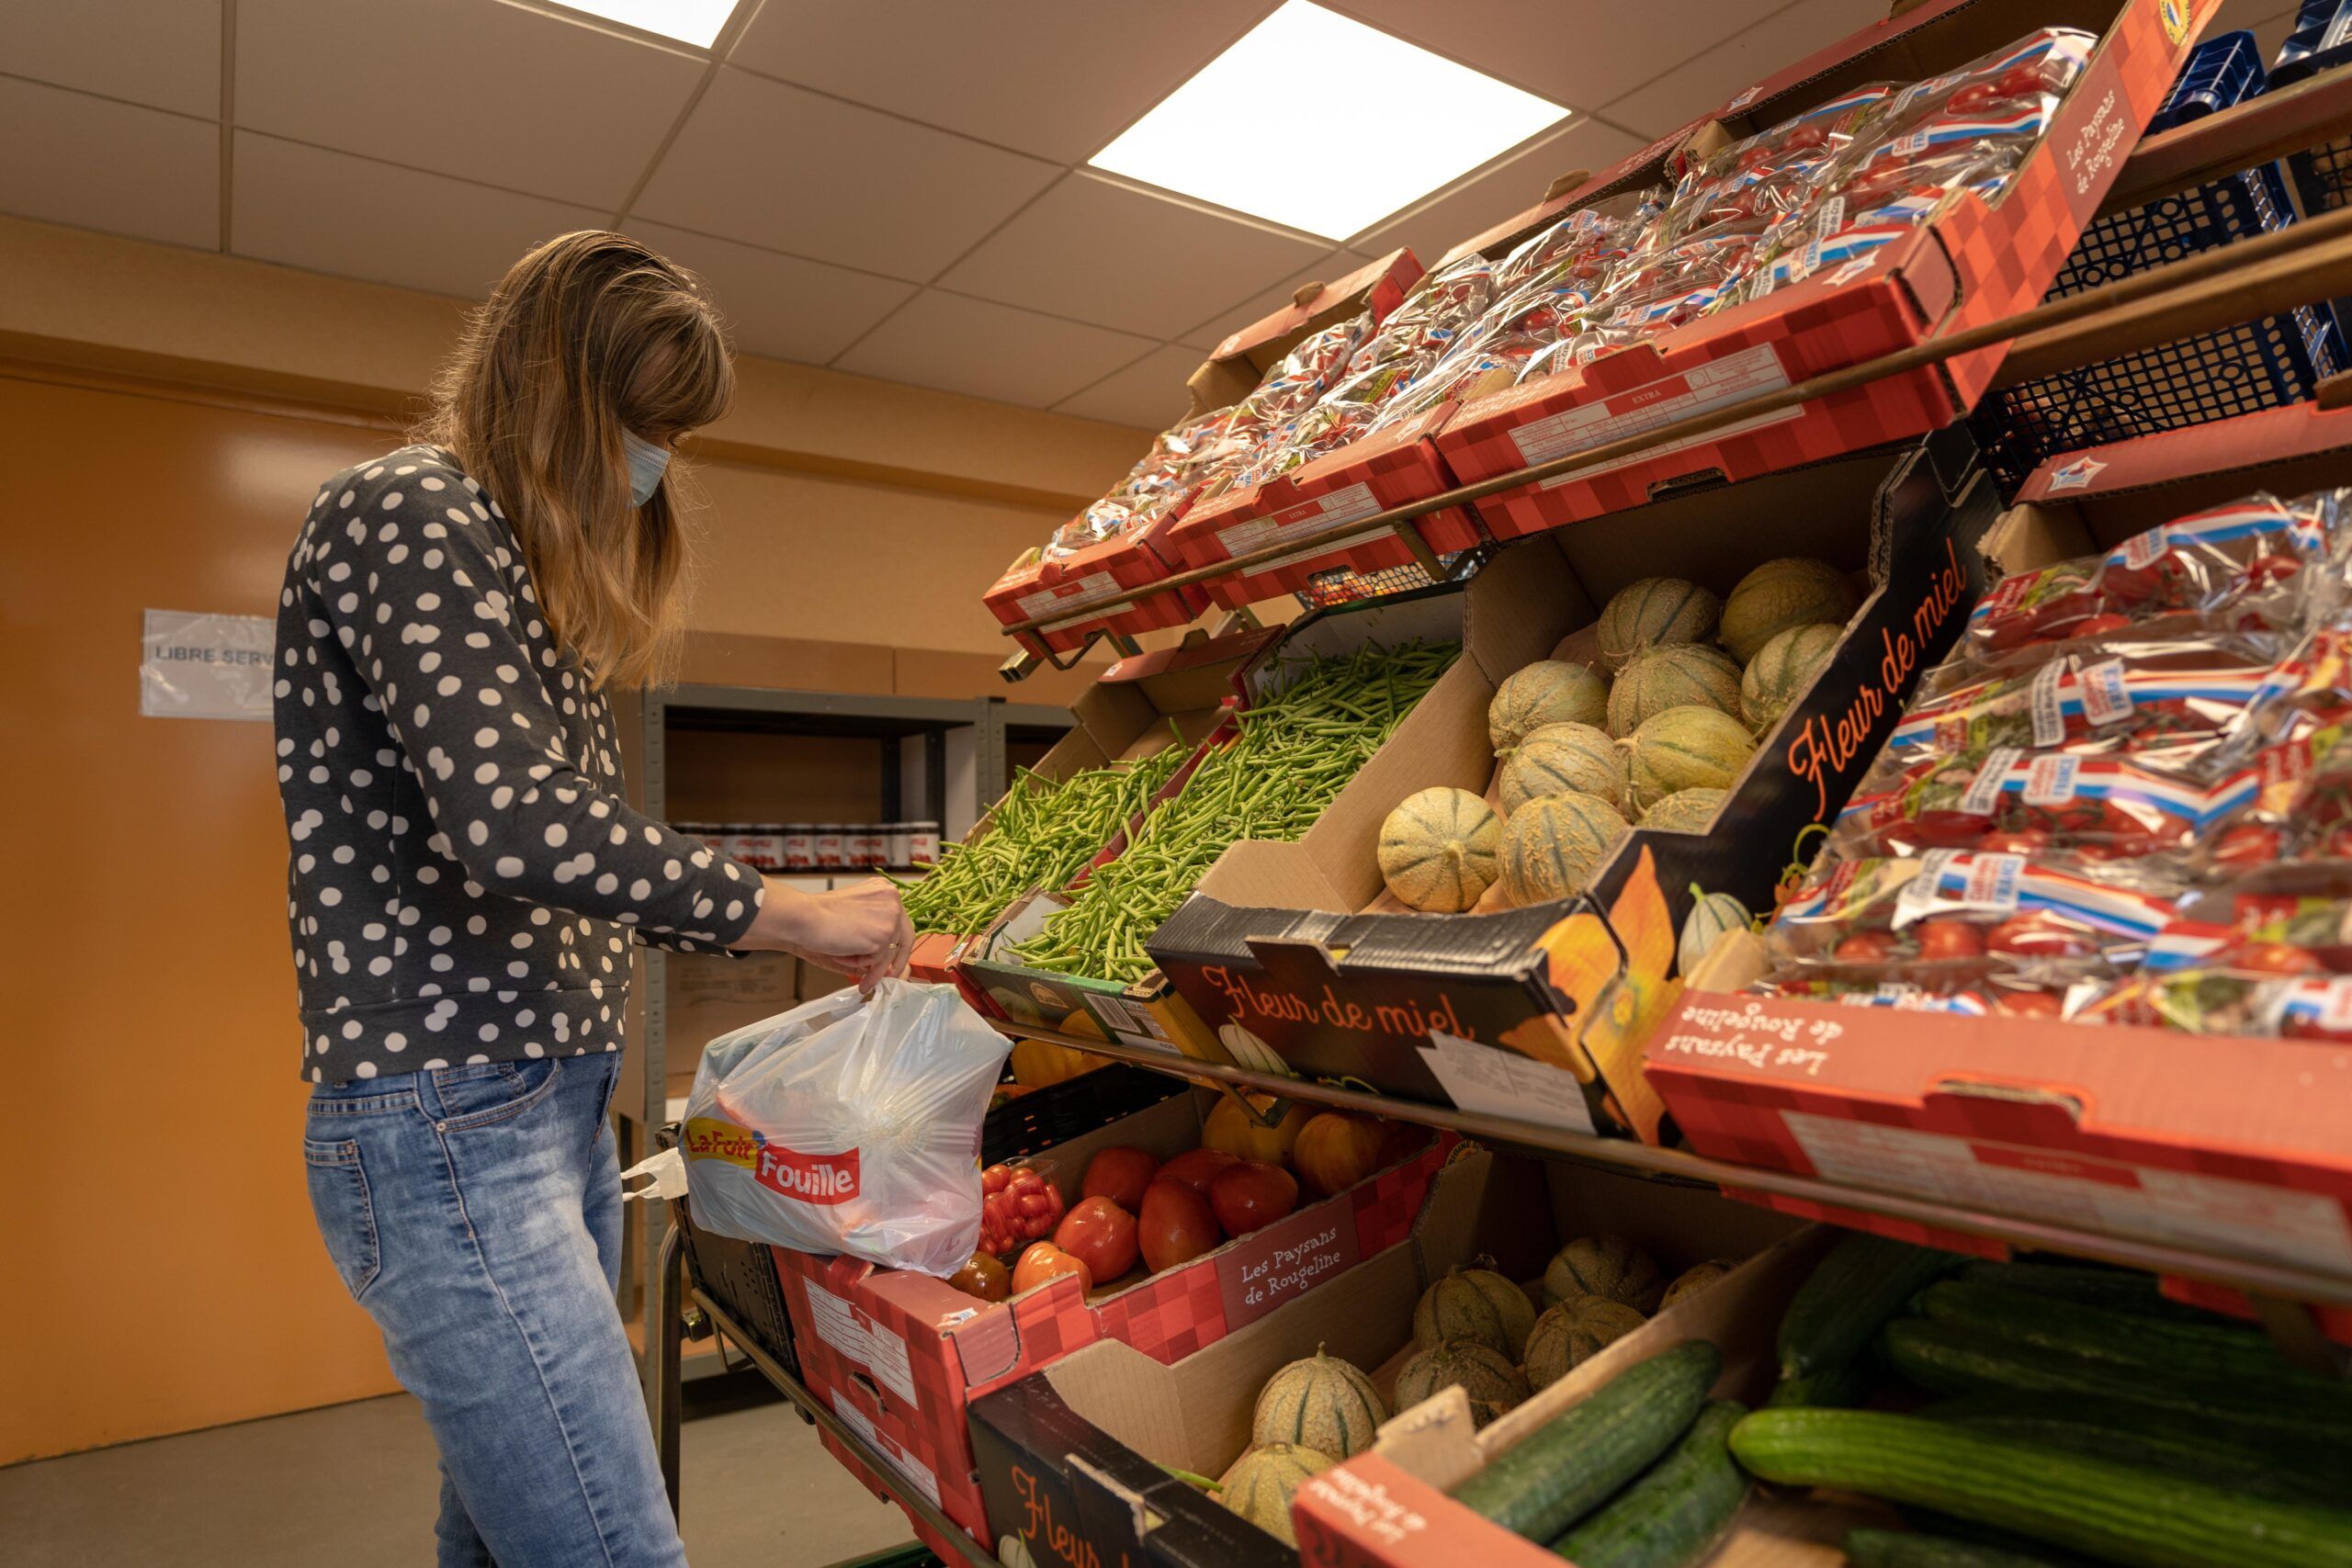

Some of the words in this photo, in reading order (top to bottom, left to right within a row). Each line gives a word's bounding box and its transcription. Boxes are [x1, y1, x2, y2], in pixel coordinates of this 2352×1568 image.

[1632, 389, 1661, 404] EXTRA
[156, 646, 215, 661] LIBRE
[1788, 684, 1883, 822] Fleur
[1882, 626, 1915, 694] de
[1913, 536, 1966, 649] miel
[1201, 965, 1320, 1023] Fleur
[1321, 985, 1374, 1031] de
[1375, 993, 1476, 1041] miel
[761, 1151, 854, 1196] Fouille
[1241, 1260, 1268, 1282] Les
[1272, 1227, 1337, 1269] Paysans
[1245, 1286, 1263, 1305] de
[1267, 1252, 1340, 1295] Rougeline
